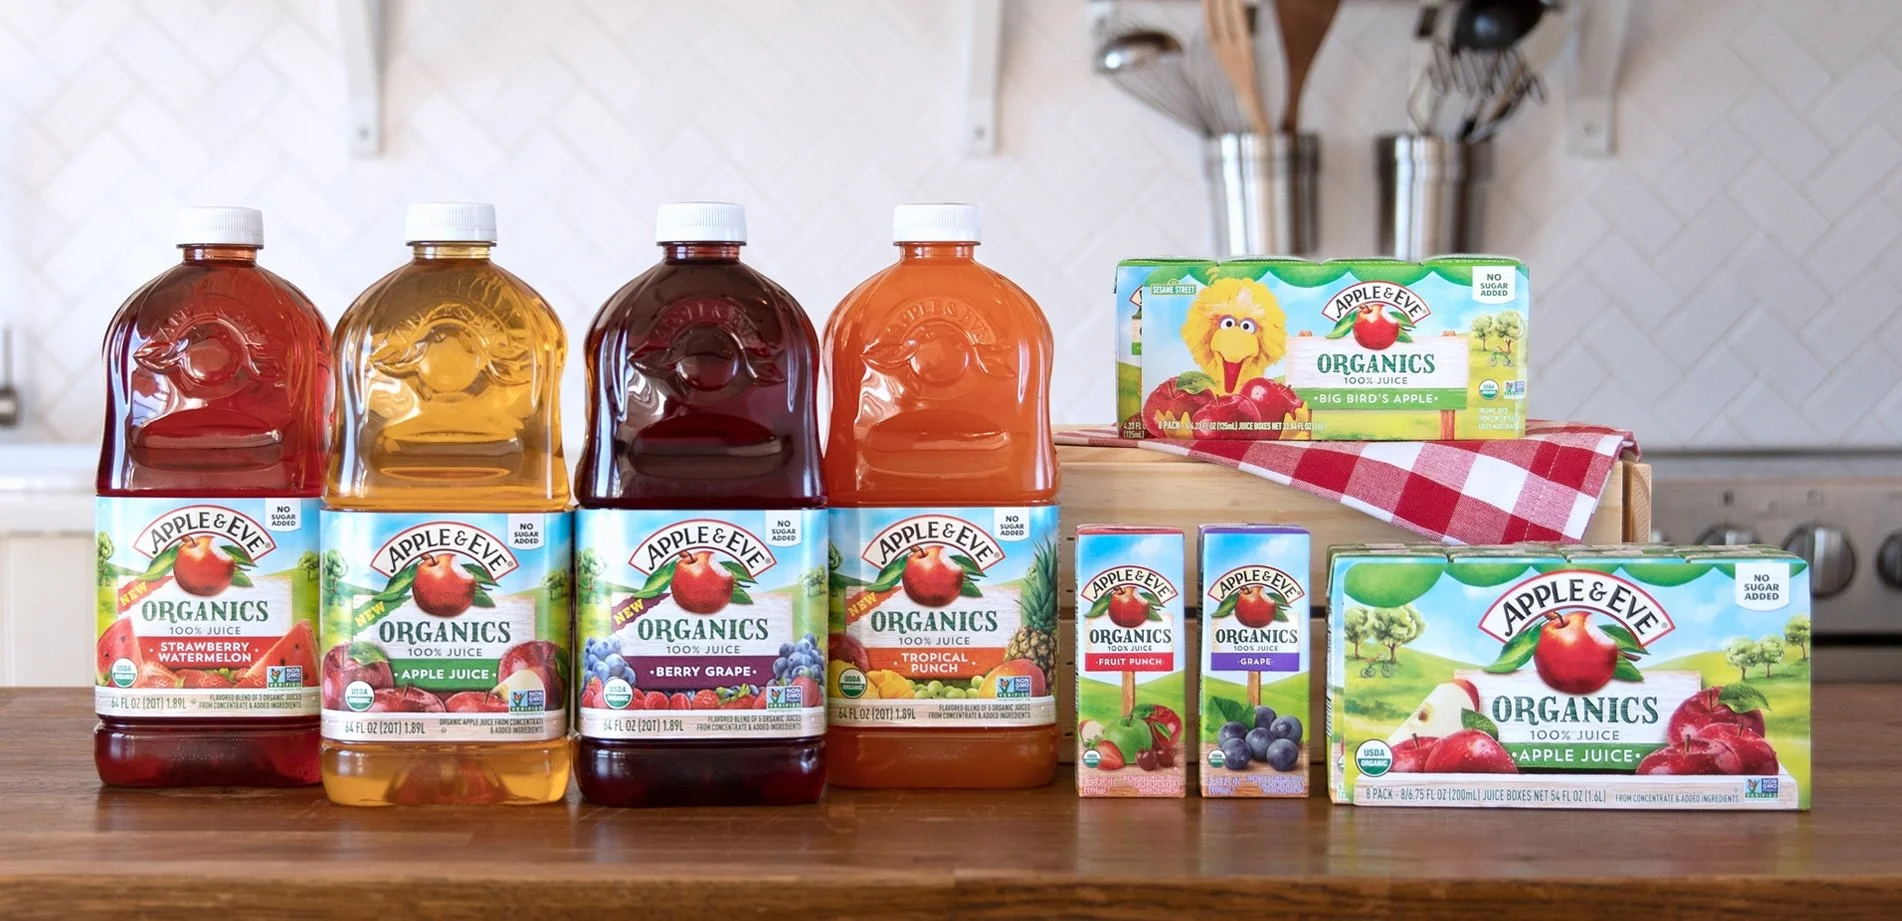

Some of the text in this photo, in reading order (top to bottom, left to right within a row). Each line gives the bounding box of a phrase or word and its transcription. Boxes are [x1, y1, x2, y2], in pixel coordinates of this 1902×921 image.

[1486, 273, 1502, 281] NO
[1152, 286, 1196, 294] SESAME STREET
[1480, 282, 1508, 290] SUGAR
[1335, 286, 1423, 319] APPLE & EVE
[1317, 354, 1435, 375] ORGANICS
[1320, 394, 1433, 404] BIG BIRD'S APPLE
[152, 512, 265, 554] APPLE & EVE
[648, 526, 765, 571] APPLE & EVE
[881, 522, 994, 565] APPLE & EVE
[389, 528, 508, 573] APPLE & EVE
[1754, 574, 1770, 582] NO
[1093, 570, 1170, 599] APPLE & EVE
[1220, 570, 1297, 599] APPLE & EVE
[1744, 583, 1780, 592] SUGAR
[120, 581, 148, 606] NEW
[1744, 592, 1780, 600] ADDED
[848, 592, 877, 616] NEW
[1504, 579, 1659, 637] APPLE & EVE
[142, 600, 269, 624] ORGANICS
[354, 601, 385, 627] NEW
[614, 598, 644, 625] NEW
[870, 610, 998, 634] ORGANICS
[170, 626, 241, 635] 100% JUICE
[379, 620, 511, 646] ORGANICS
[638, 618, 768, 642] ORGANICS
[898, 637, 970, 646] 100% JUICE
[1090, 629, 1172, 645] ORGANICS
[1216, 629, 1298, 644] ORGANICS
[160, 642, 250, 652] STRAWBERRY
[408, 648, 483, 657] 100% JUICE
[666, 646, 740, 654] 100% JUICE
[158, 652, 252, 662] WATERMELON
[902, 653, 968, 663] TROPICAL
[1098, 658, 1162, 666] FRUIT PUNCH
[1240, 658, 1272, 666] GRAPE
[401, 669, 489, 679] APPLE JUICE
[656, 666, 751, 676] BERRY GRAPE
[912, 664, 958, 674] PUNCH
[111, 697, 119, 708] 64
[120, 697, 129, 708] FL
[131, 697, 140, 708] OZ
[166, 697, 186, 708] 1.89L
[839, 708, 848, 719] 64
[849, 708, 858, 719] FL
[860, 708, 870, 719] OZ
[896, 708, 916, 719] 1.89L
[1492, 696, 1658, 726] ORGANICS
[356, 722, 365, 733] FL
[367, 722, 378, 733] OZ
[404, 722, 426, 733] 1.89L
[614, 720, 624, 731] FL
[626, 720, 636, 731] OZ
[663, 720, 684, 731] 1.89L
[1530, 730, 1620, 740] 100% JUICE
[1364, 749, 1385, 757] USDA
[1518, 750, 1633, 762] APPLE JUICE
[1366, 788, 1606, 803] 8 PACK 8/6.75 FL OZ (200mL) JUICE BOXES NET 54 FL OZ (1.6L)
[1616, 794, 1632, 802] FROM
[1634, 794, 1674, 802] CONCENTRATE
[1681, 794, 1700, 802] ADDED
[1702, 794, 1739, 802] INGREDIENTS
